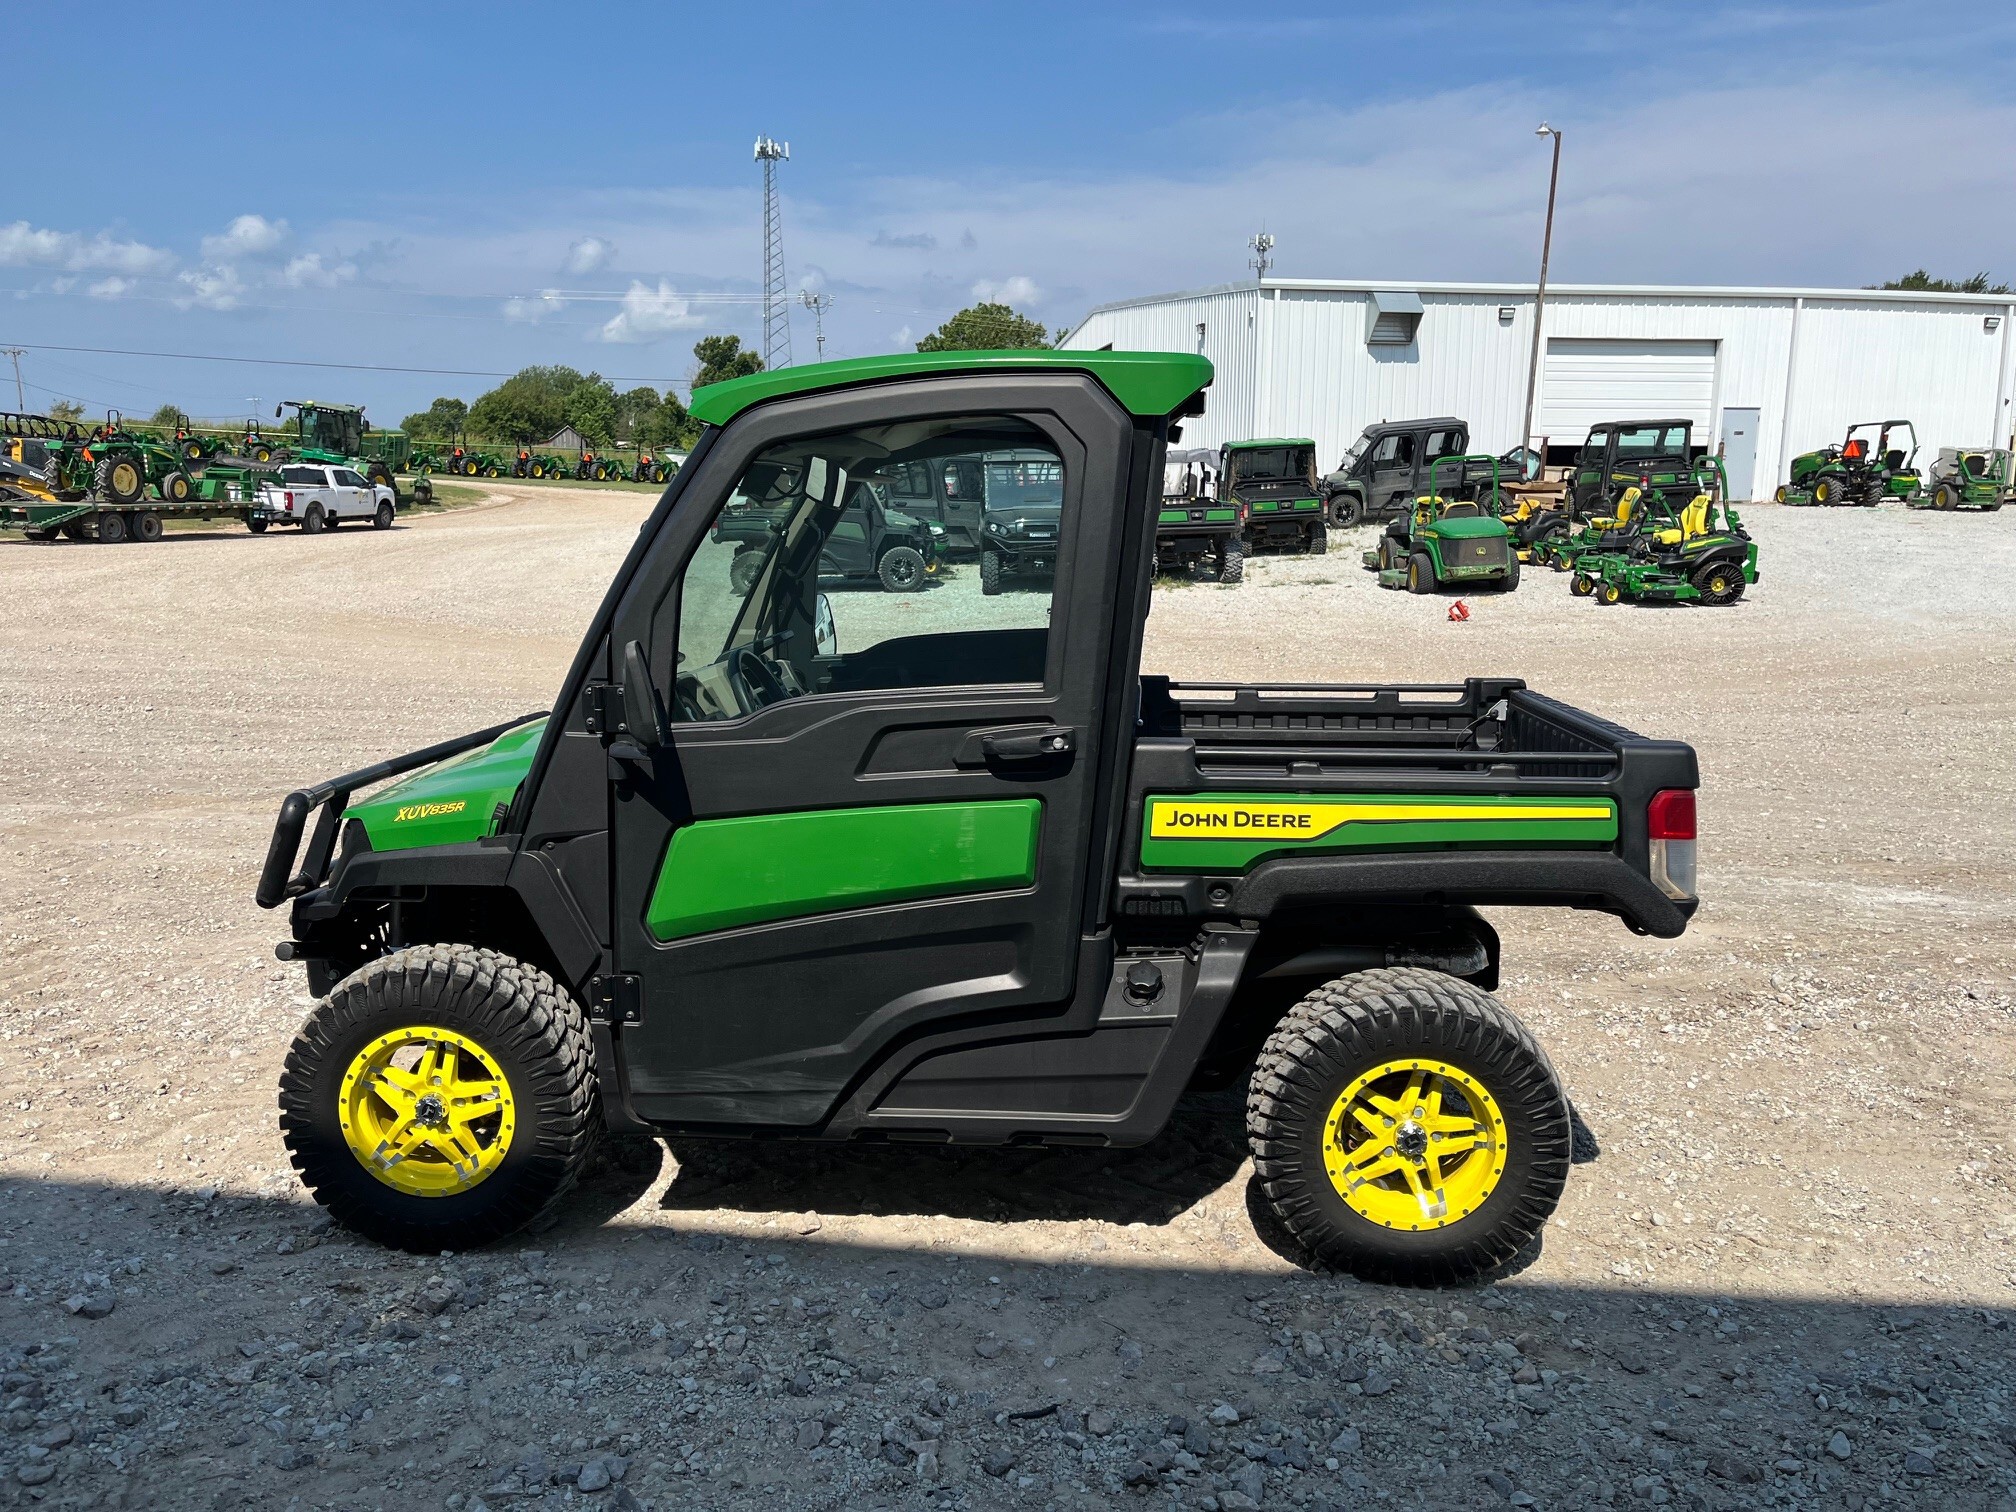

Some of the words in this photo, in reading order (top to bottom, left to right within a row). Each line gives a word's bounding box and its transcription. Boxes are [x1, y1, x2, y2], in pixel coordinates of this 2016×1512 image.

[394, 801, 466, 822] XUV835R
[1166, 810, 1228, 827] JOHN
[1234, 811, 1311, 828] DEERE
